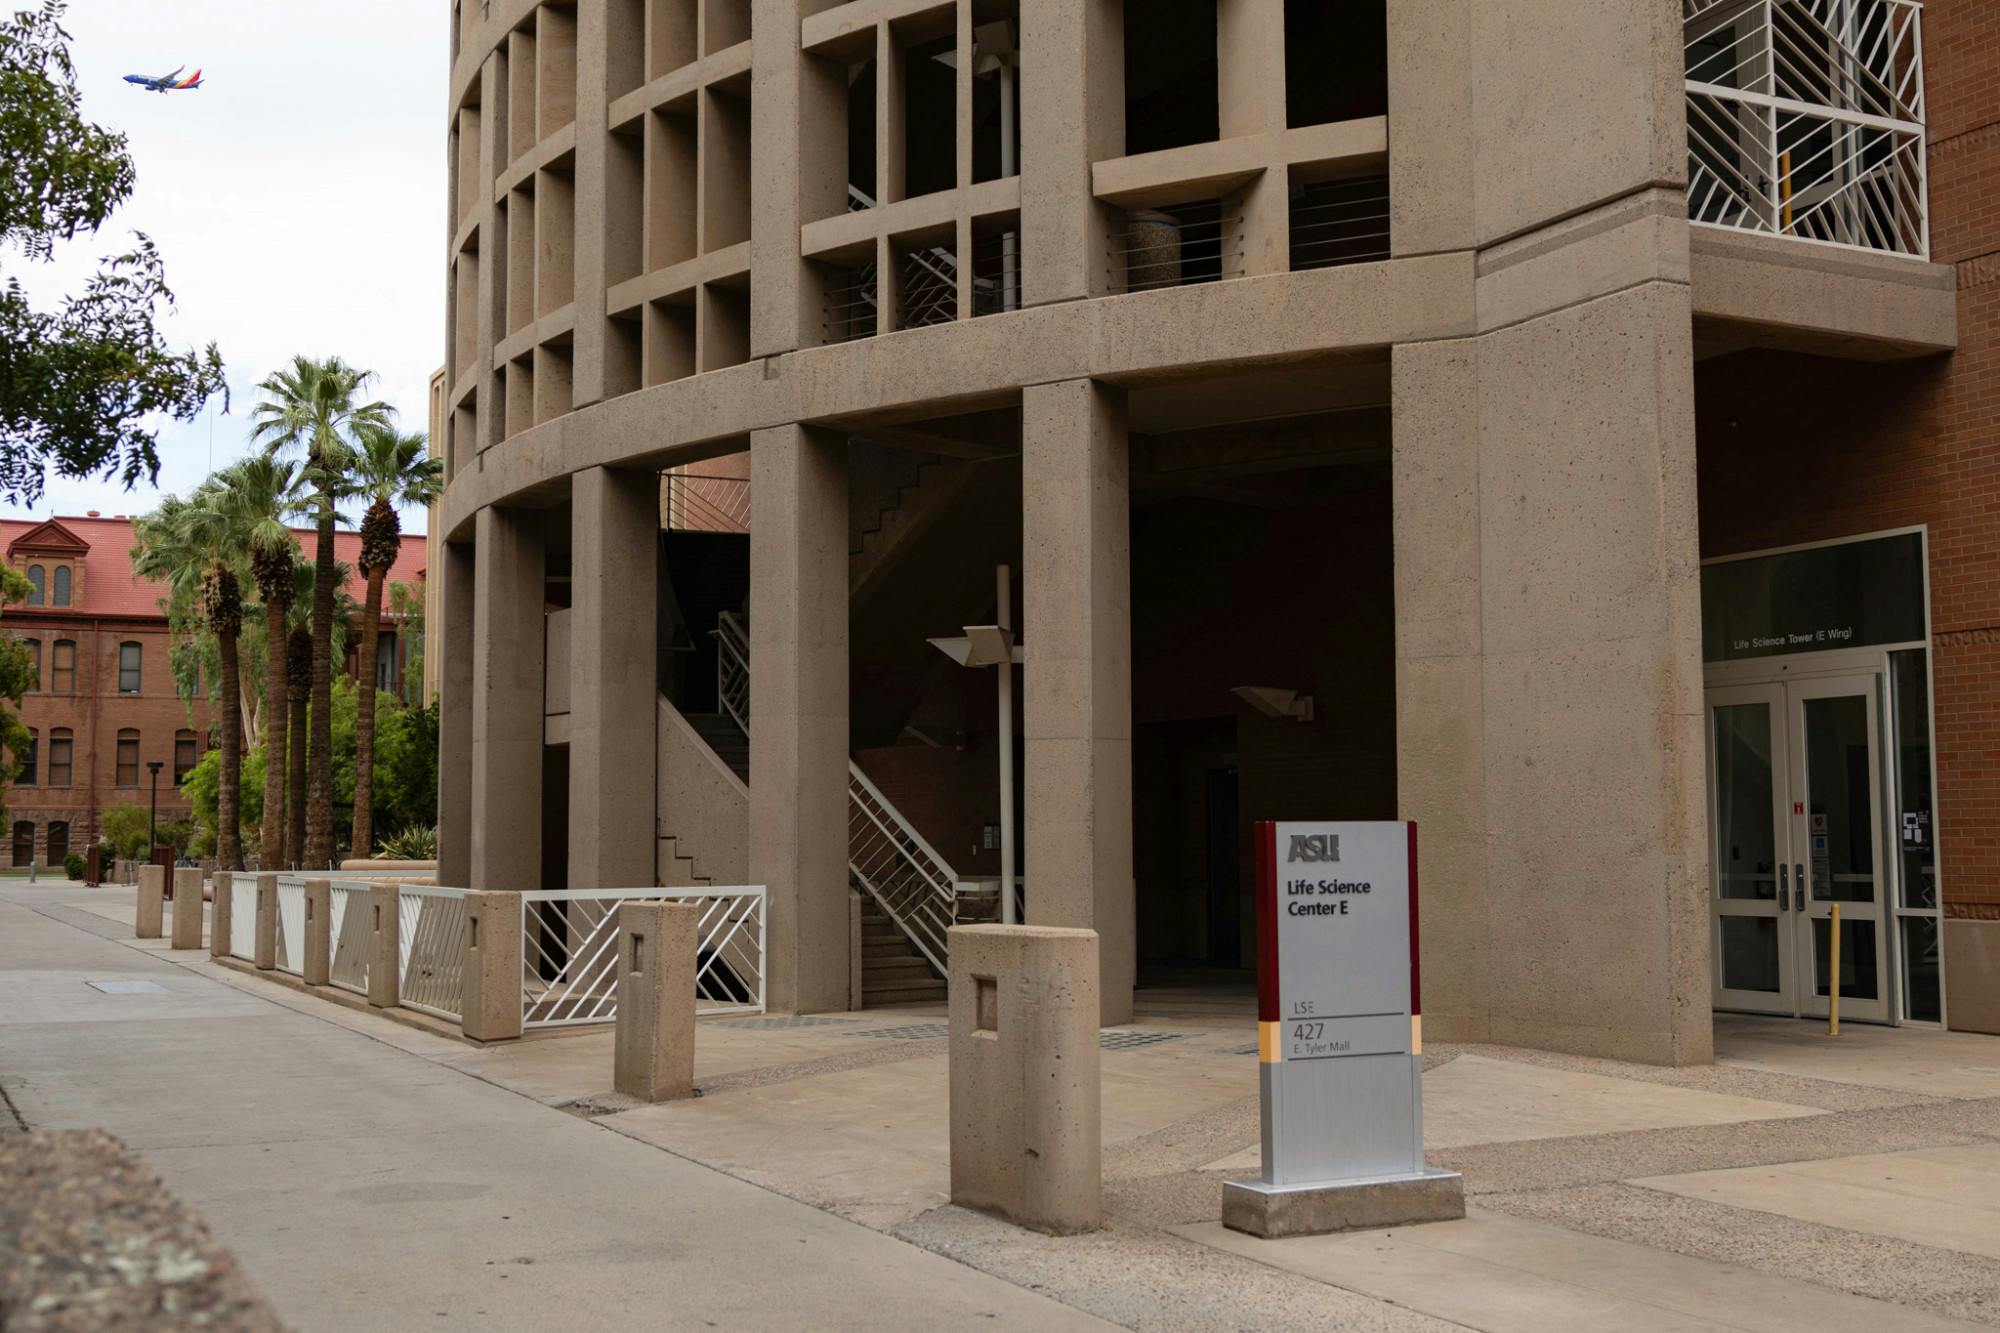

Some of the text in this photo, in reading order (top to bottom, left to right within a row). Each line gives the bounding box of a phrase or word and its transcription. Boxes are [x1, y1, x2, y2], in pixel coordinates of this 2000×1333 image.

[1734, 627, 1852, 650] Life Science Tower (E Wing)
[1287, 834, 1340, 863] ASU
[1287, 879, 1371, 895] Life Science
[1287, 900, 1349, 916] Center E
[1294, 1001, 1314, 1014] LSE
[1294, 1023, 1324, 1041] 427
[1305, 1042, 1326, 1055] Tyler
[1330, 1040, 1350, 1051] Mall
